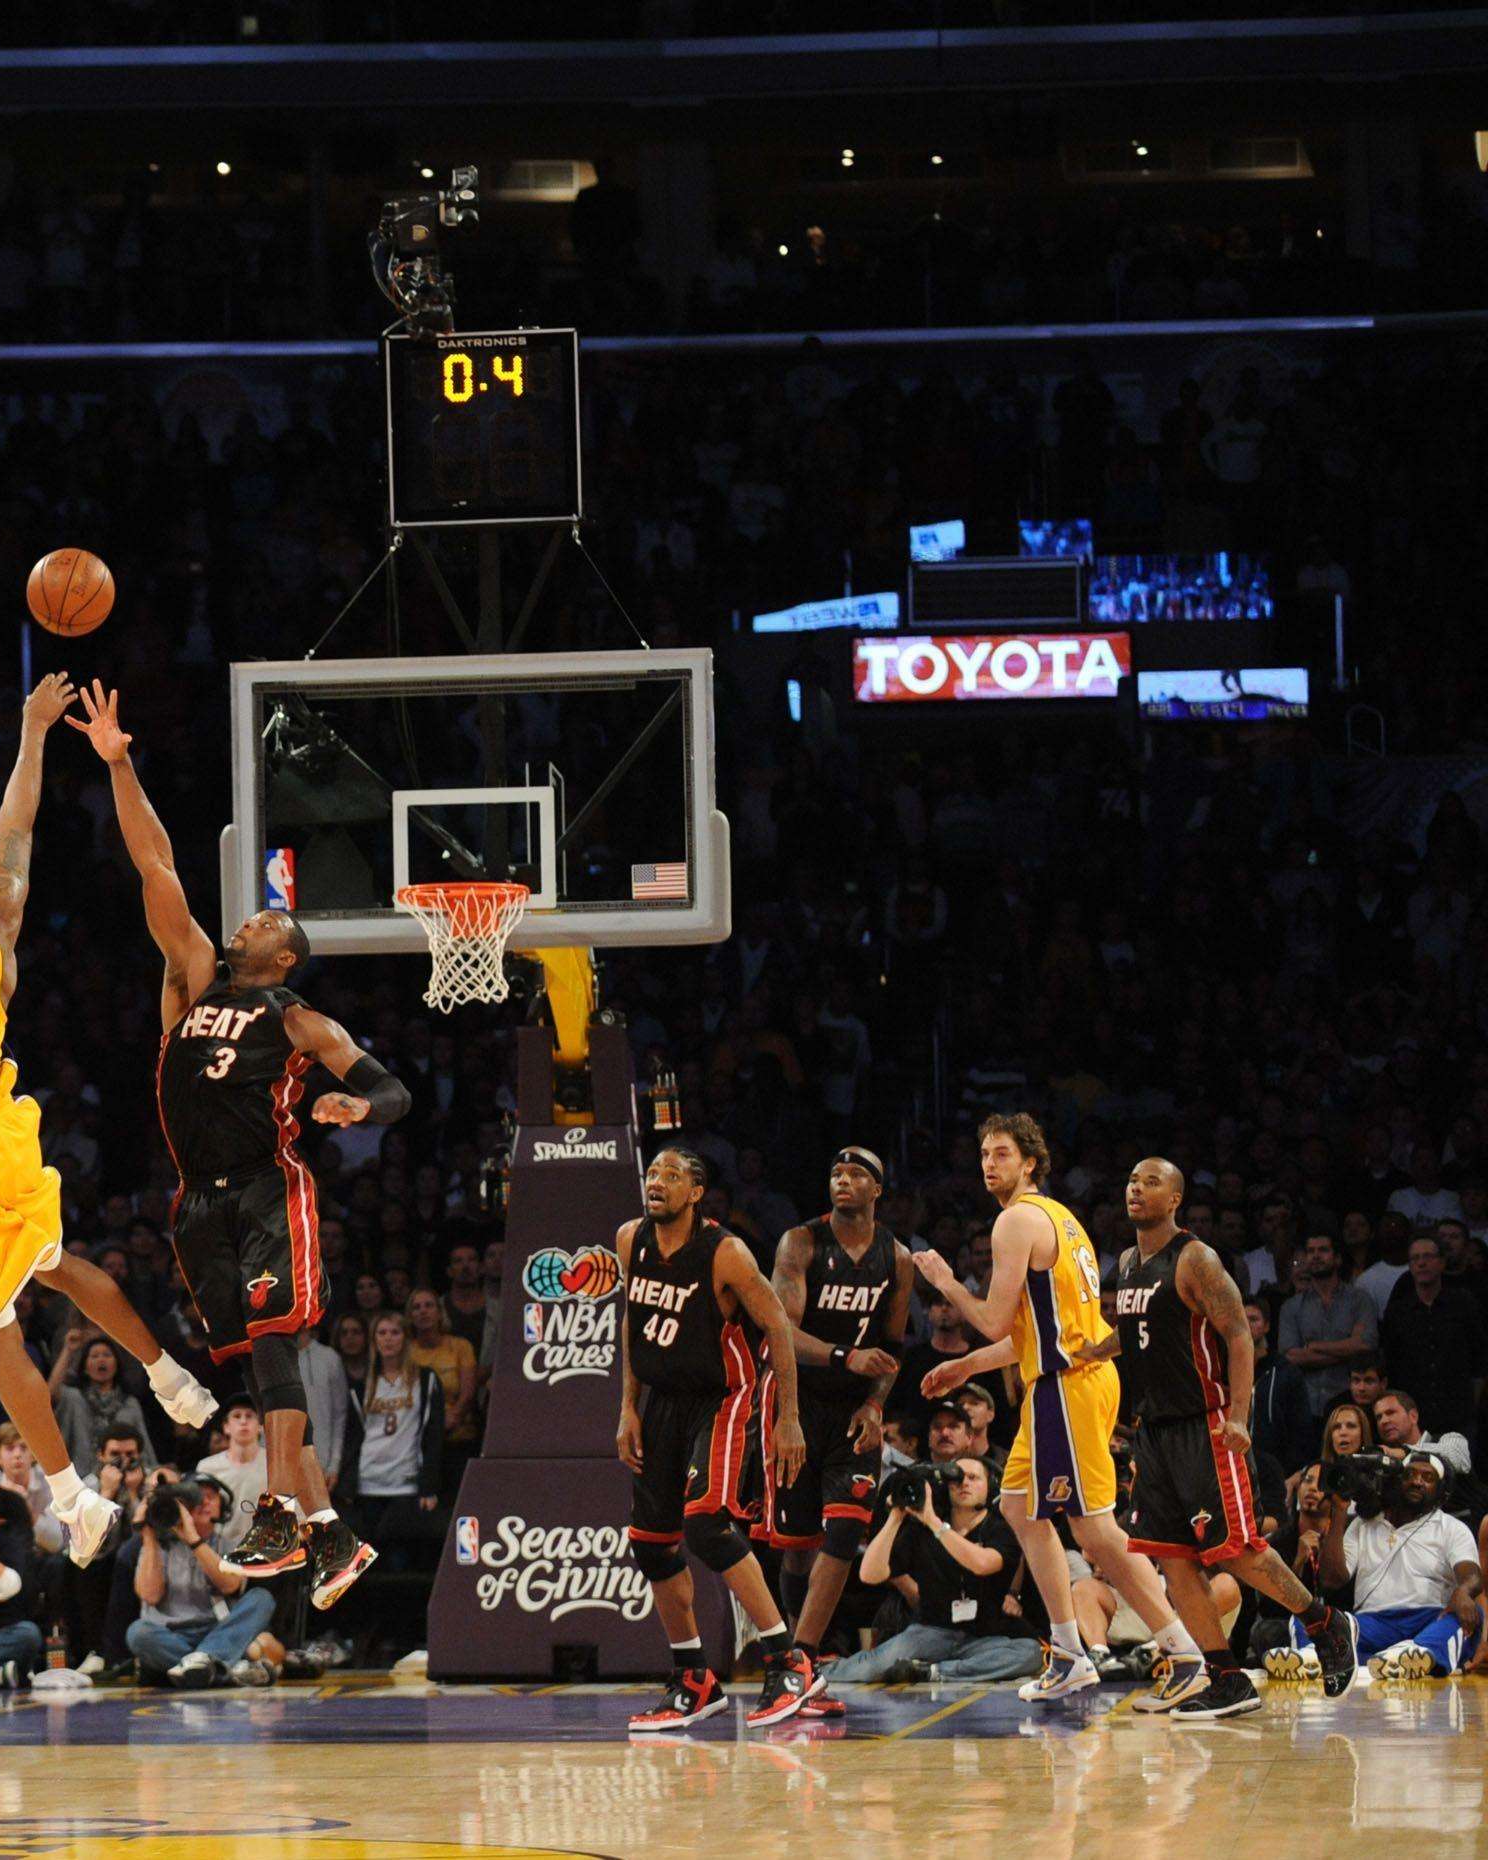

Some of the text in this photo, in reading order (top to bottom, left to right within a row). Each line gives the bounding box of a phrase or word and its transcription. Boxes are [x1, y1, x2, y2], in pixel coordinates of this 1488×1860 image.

[438, 336, 527, 349] DAKTRONICS
[443, 353, 524, 403] 0.4
[857, 639, 1123, 693] TOYOTA
[180, 1004, 266, 1041] HEAT
[206, 1046, 237, 1080] 3
[533, 1140, 618, 1162] SPALDING
[628, 1276, 699, 1313] HEAT
[817, 1278, 890, 1312] HEAT
[1116, 1280, 1162, 1315] HEAT
[544, 1302, 617, 1343] NBA
[643, 1313, 680, 1348] 40
[853, 1315, 870, 1347] 7
[1138, 1320, 1150, 1351] 5
[522, 1342, 616, 1382] Cares
[384, 1412, 398, 1436] 8
[476, 1558, 655, 1622] of Giving
